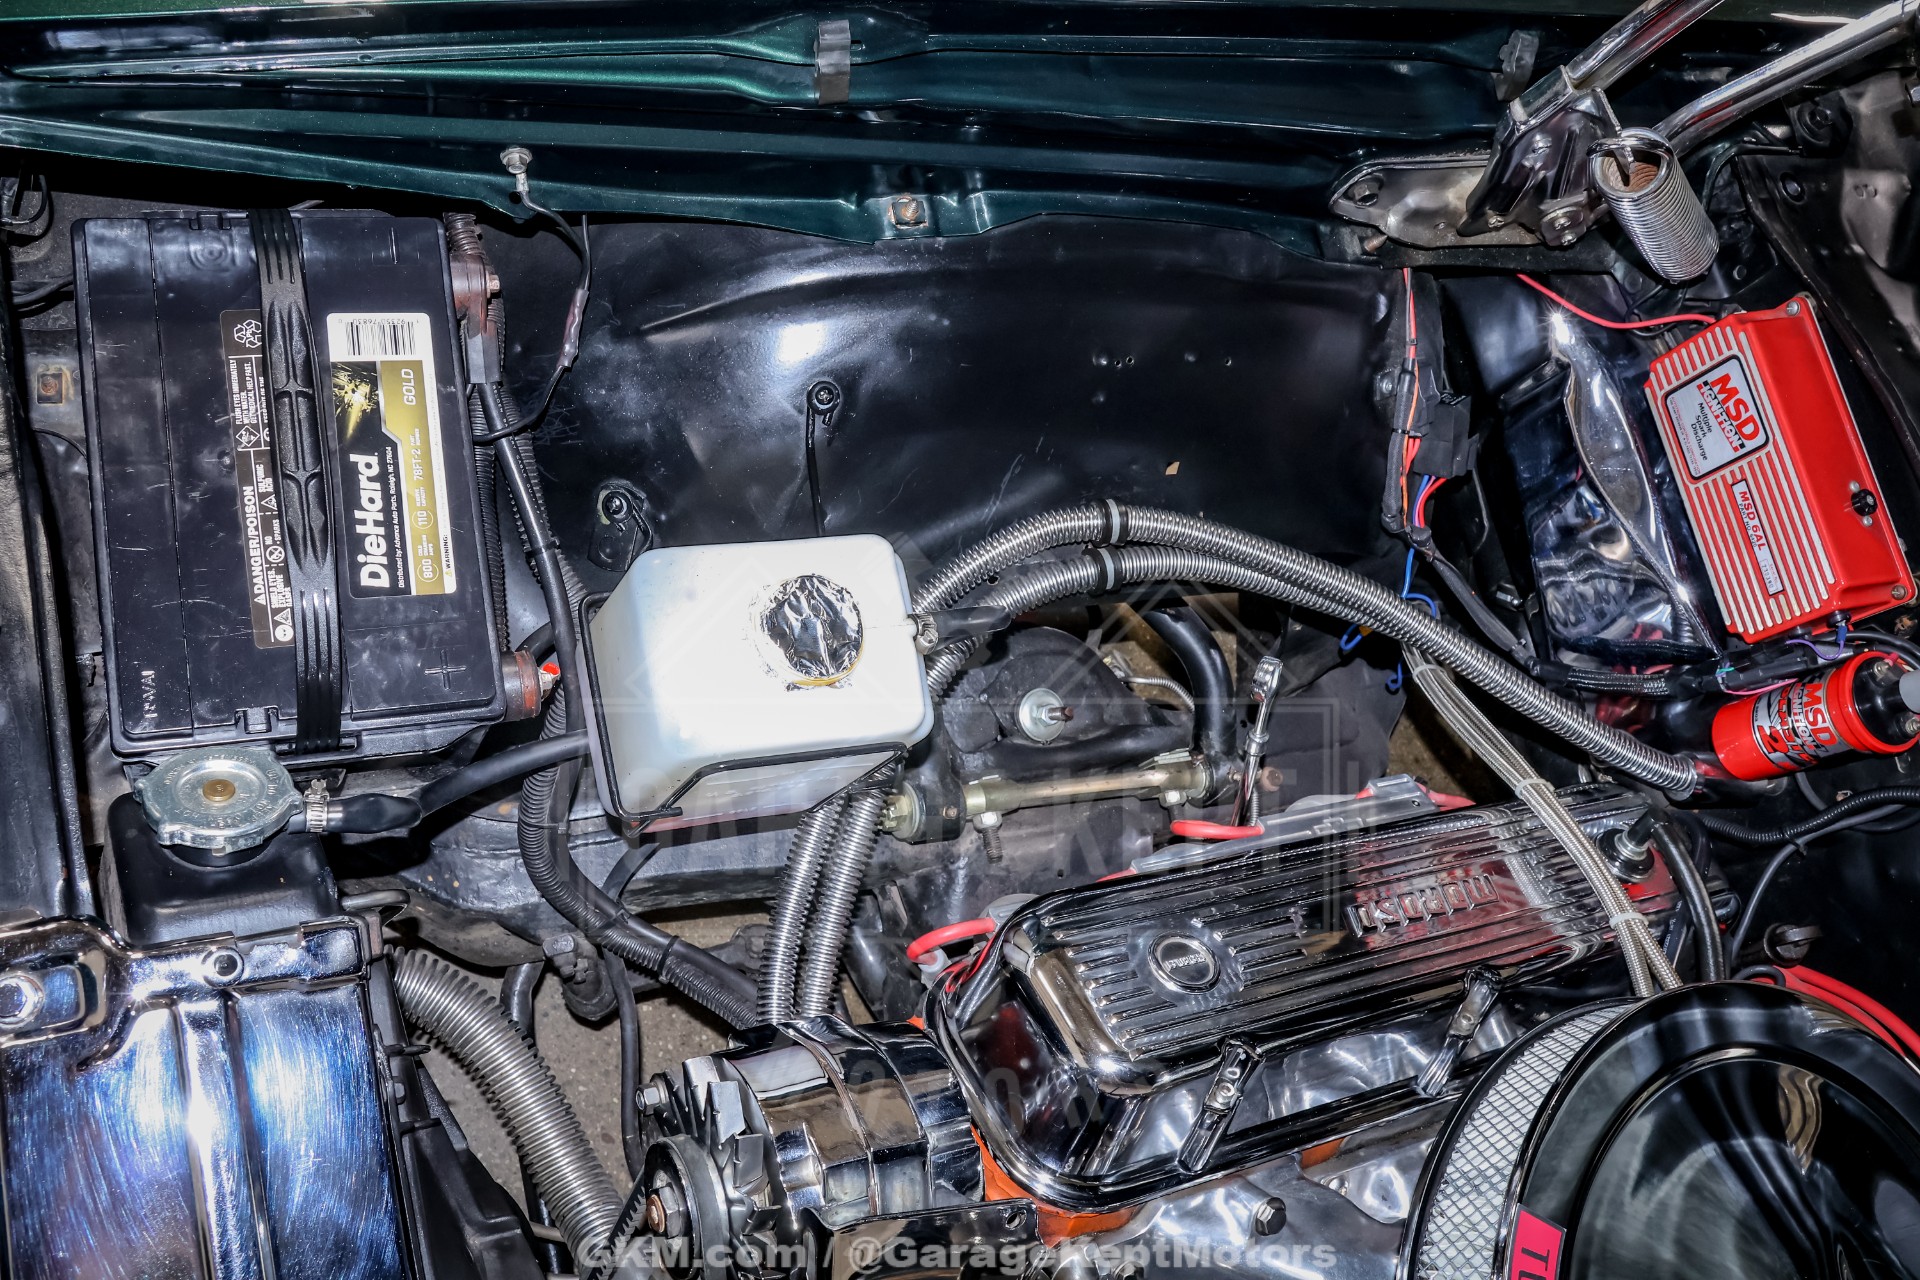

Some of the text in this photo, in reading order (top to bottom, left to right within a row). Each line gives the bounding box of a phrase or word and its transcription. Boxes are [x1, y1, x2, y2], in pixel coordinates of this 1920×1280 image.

[230, 359, 243, 424] FLUSH EYES IMMEDIATELY
[246, 377, 254, 390] HELP
[402, 369, 416, 405] GOLD
[242, 410, 250, 424] WITH
[1696, 402, 1714, 434] Multiple
[1698, 384, 1743, 449] IGNITION
[1709, 372, 1763, 444] MSD
[1693, 414, 1708, 438] Spark
[1689, 423, 1709, 462] Discharge
[413, 448, 423, 481] 78FT-2
[418, 510, 427, 526] 110
[1738, 503, 1748, 519] PART
[1739, 490, 1767, 551] MSD 6AL
[243, 485, 265, 594] DANGER/POISON
[265, 536, 272, 545] NO
[443, 534, 451, 569] WARNING:
[396, 557, 405, 588] Distributed
[422, 558, 433, 579] 800
[1804, 681, 1839, 747] MSD
[1757, 726, 1789, 754] 2
